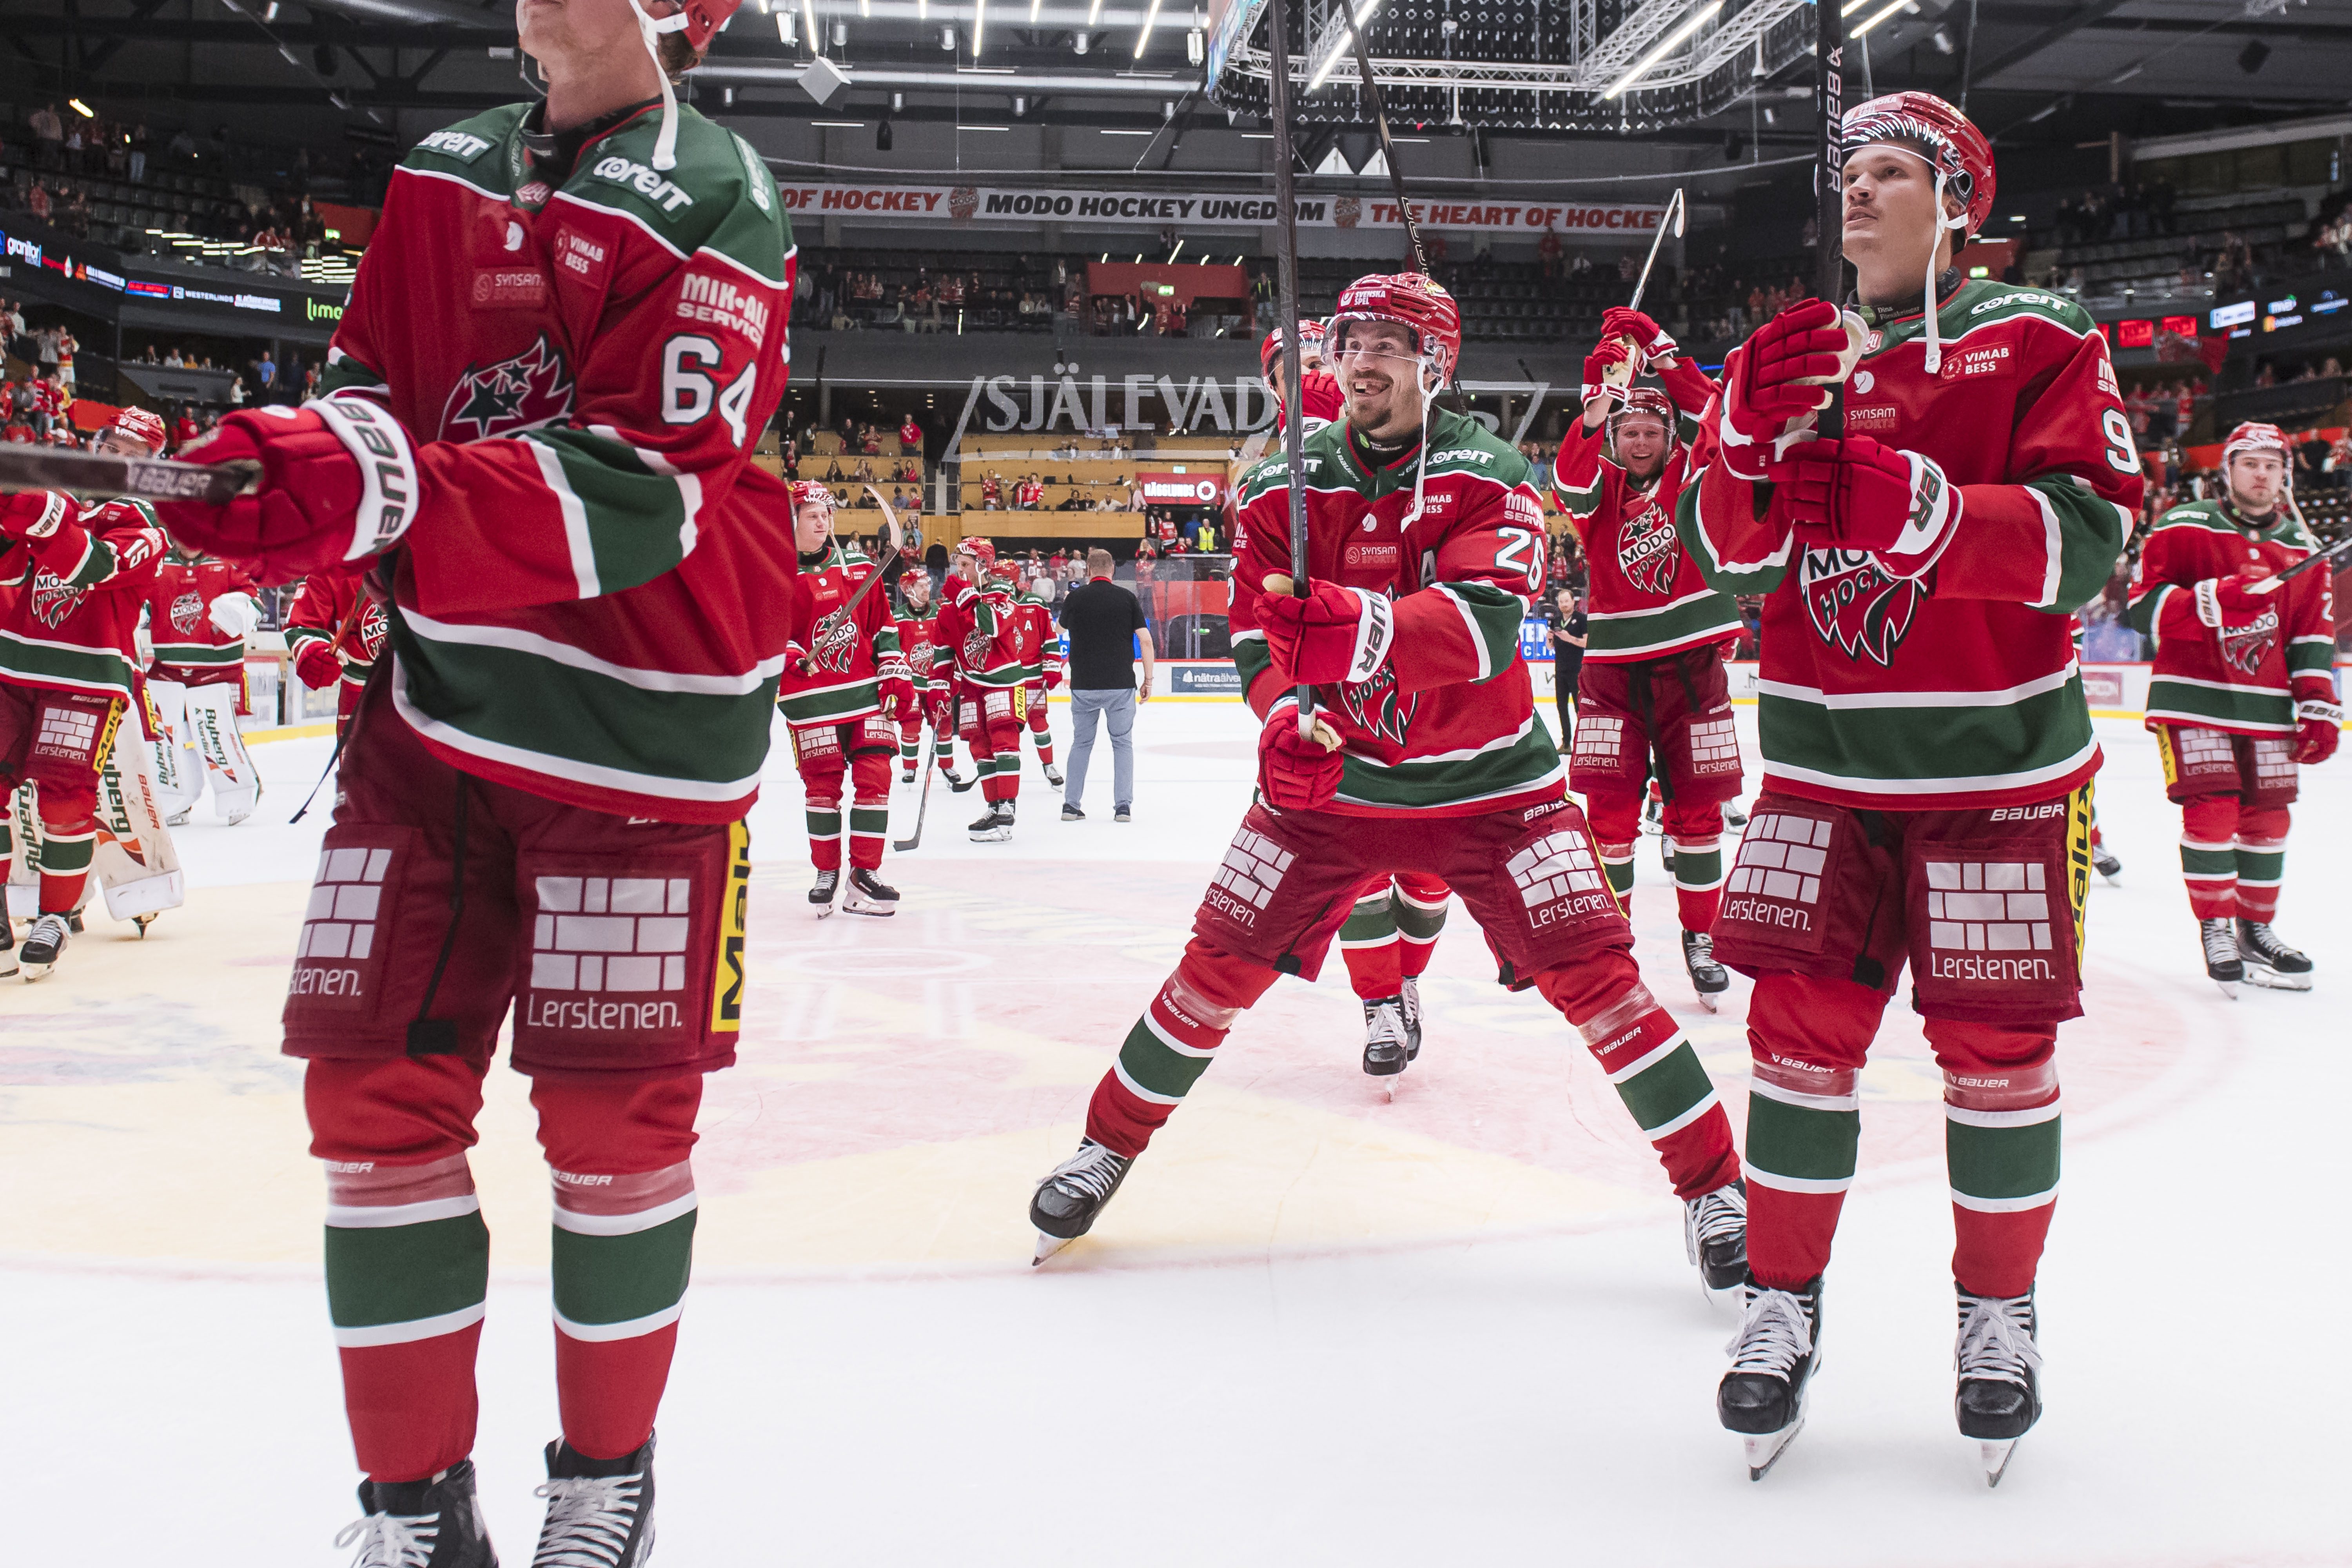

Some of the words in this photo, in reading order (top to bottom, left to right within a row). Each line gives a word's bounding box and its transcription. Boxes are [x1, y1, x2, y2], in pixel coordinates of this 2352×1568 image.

[1828, 70, 1841, 193] BAUER
[782, 189, 818, 208] OF
[821, 190, 943, 211] HOCKEY
[985, 194, 1073, 215] MODO
[1078, 197, 1195, 218] HOCKEY
[1200, 200, 1326, 221] UNGDM
[1371, 203, 1426, 224] THE
[1429, 205, 1521, 225] HEART
[1524, 208, 1563, 227] OF
[1566, 209, 1671, 229] HOCKEY
[570, 235, 604, 262] VIMAB
[565, 252, 589, 274] BESS
[1354, 297, 1370, 305] SPEL
[1965, 347, 2009, 363] VIMAB
[1965, 361, 1996, 375] BESS
[660, 331, 758, 450] 64
[1850, 408, 1896, 419] SYNSAM
[1850, 419, 1895, 430] SPORTS
[332, 400, 406, 554] BAUER
[1257, 458, 1322, 483] corIT
[1336, 455, 1361, 482] BAUER
[137, 470, 212, 497] BAUER
[1144, 482, 1195, 497] HÄGGLUNDS
[1422, 495, 1452, 503] VIMAB
[123, 538, 150, 569] 15
[1361, 546, 1396, 555] SYNSAM
[1621, 526, 1675, 566] MODO
[1361, 555, 1397, 564] SPORTS
[1420, 549, 1437, 590] A
[1494, 526, 1545, 591] 26
[1633, 540, 1675, 583] HOCKEY
[1807, 547, 1867, 580] MO
[36, 575, 60, 589] MO
[1820, 566, 1892, 626] HOCK
[992, 601, 1013, 620] 34
[363, 621, 389, 639] MO
[1024, 620, 1033, 631] A
[1357, 589, 1386, 673] UER
[911, 649, 934, 660] MODO
[965, 635, 989, 655] MODO
[878, 668, 913, 677] BAUE
[1194, 672, 1241, 683] nätraälve
[1349, 666, 1395, 710] HOCK
[71, 695, 109, 704] BAUER
[35, 744, 87, 762] Lerstenen.
[1573, 755, 1619, 768] Lerstenen.
[1693, 760, 1739, 774] Lerstenen.
[138, 774, 160, 829] BAUER
[1989, 804, 2064, 821] BAUER
[1528, 894, 1612, 929] Lerstenen.
[1722, 896, 1811, 931] Lerstenen.
[1931, 953, 2055, 980] Lerstenen.
[527, 993, 682, 1029] Lerstenen.
[1163, 999, 1199, 1029] BAUER
[1603, 1026, 1642, 1054] BAUER
[1781, 1057, 1836, 1074] BAUER
[1958, 1078, 2009, 1088] BAUER
